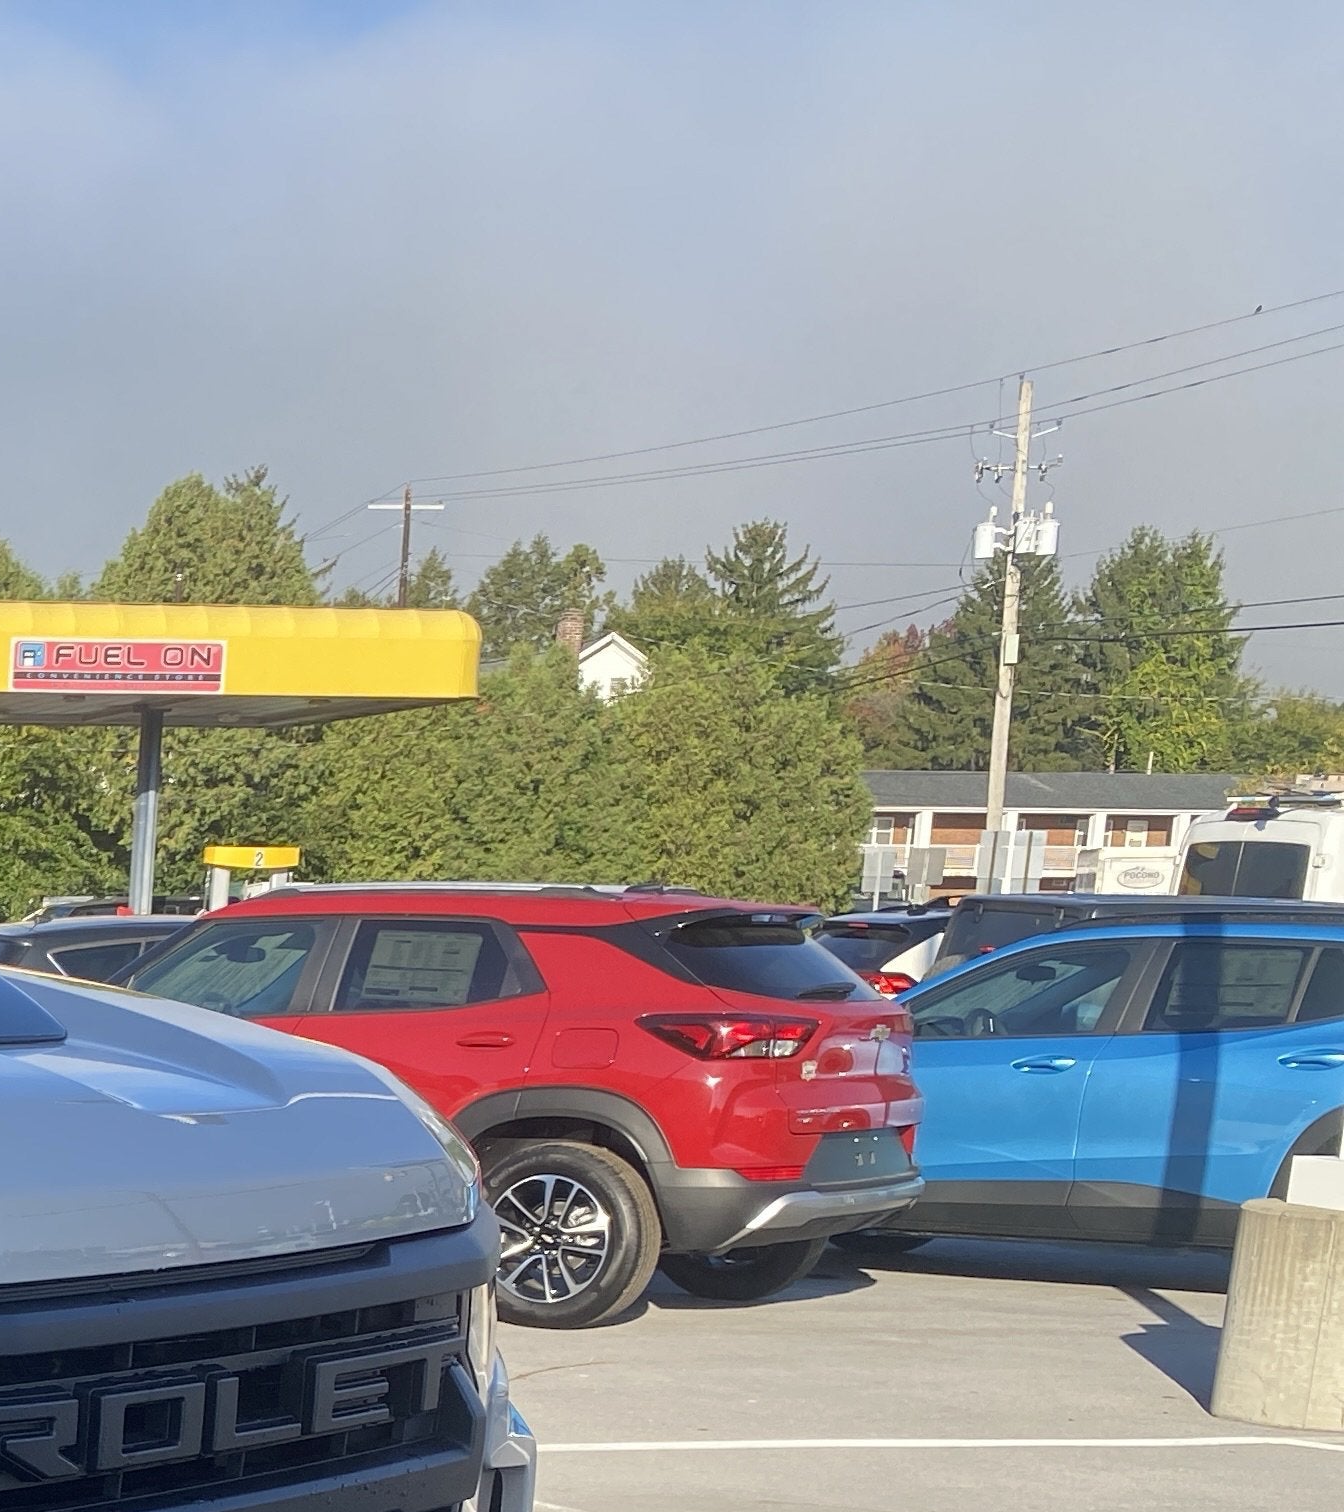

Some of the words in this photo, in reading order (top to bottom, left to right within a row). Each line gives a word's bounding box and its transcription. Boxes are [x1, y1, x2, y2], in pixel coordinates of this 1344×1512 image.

[54, 645, 145, 666] FUEL
[163, 647, 212, 667] ON
[25, 672, 144, 681] CONVENIENCE
[255, 851, 264, 867] 2
